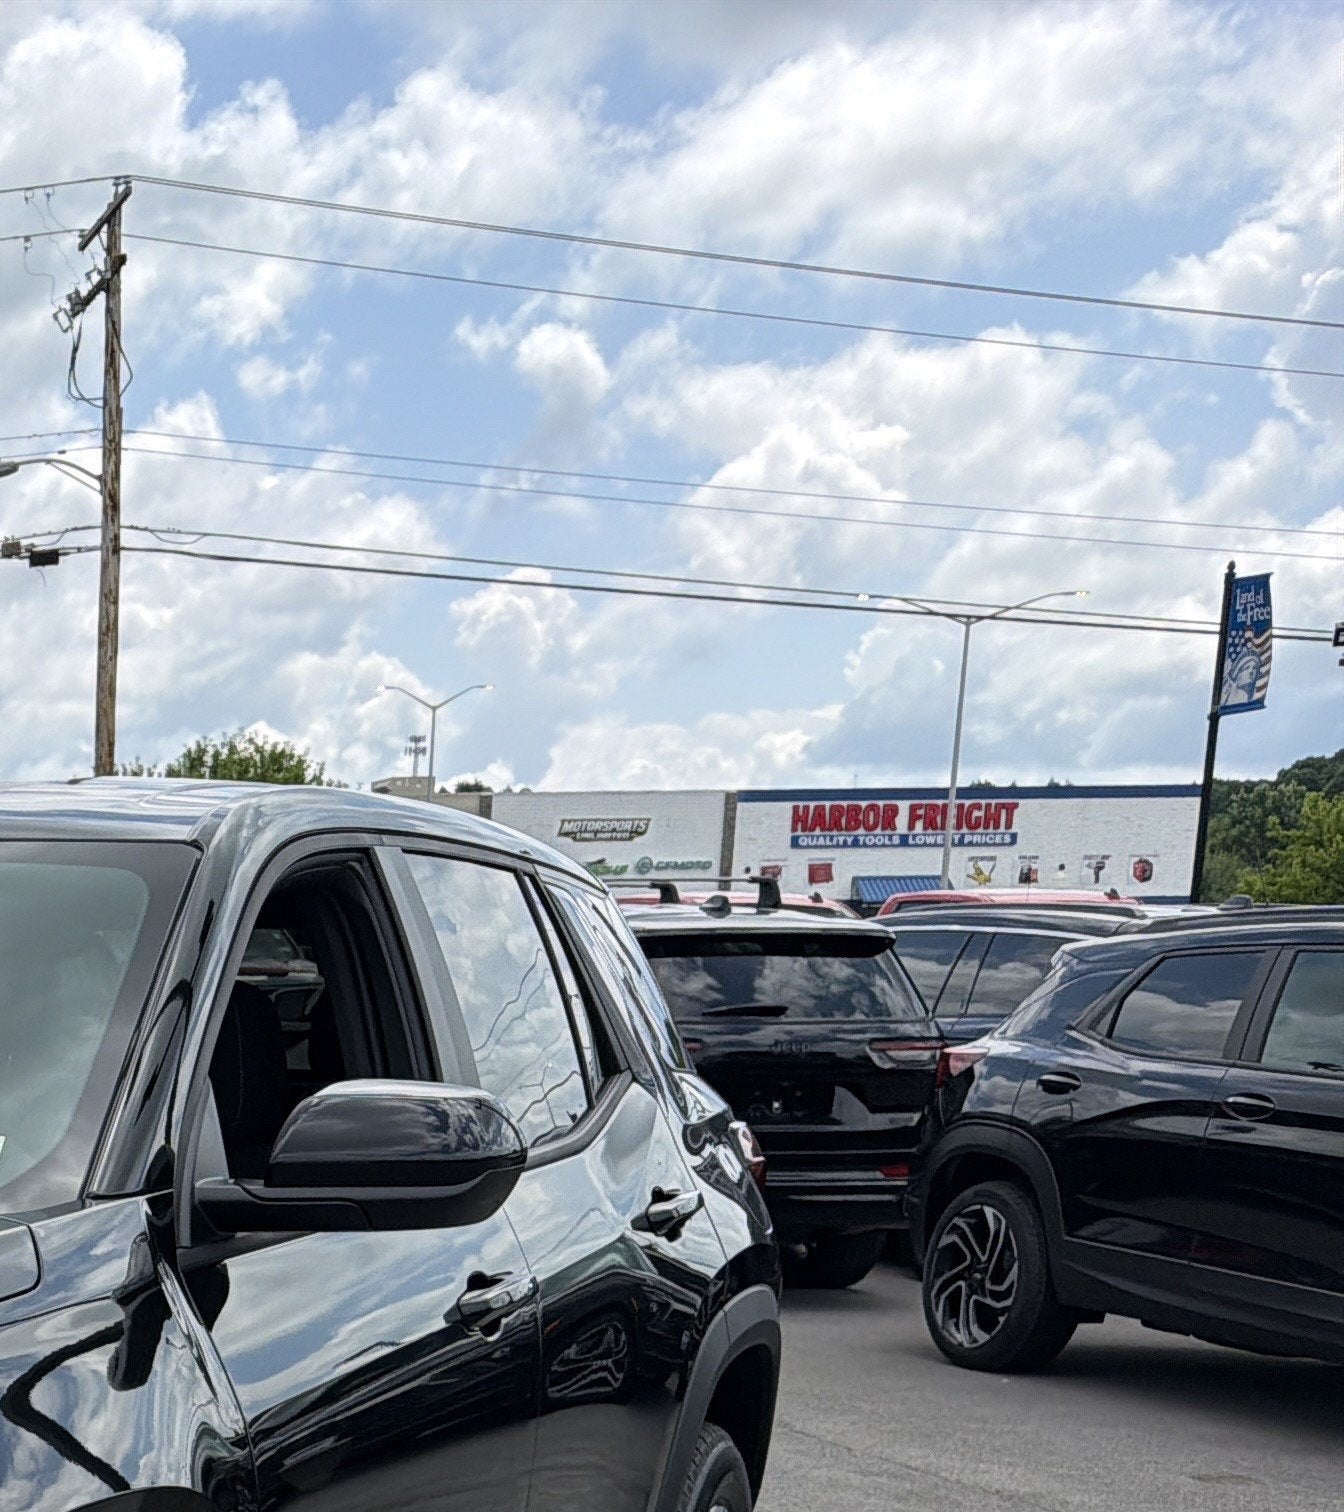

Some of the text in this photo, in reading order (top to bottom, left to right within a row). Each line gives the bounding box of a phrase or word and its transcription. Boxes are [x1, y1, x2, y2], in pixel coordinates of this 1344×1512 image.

[1235, 585, 1255, 610] Land
[1246, 603, 1271, 625] Free
[561, 820, 648, 833] MOTORSPORTS
[790, 803, 900, 832] HARBOR
[798, 833, 1012, 846] QUALITY TOOLS LOWET PRICES
